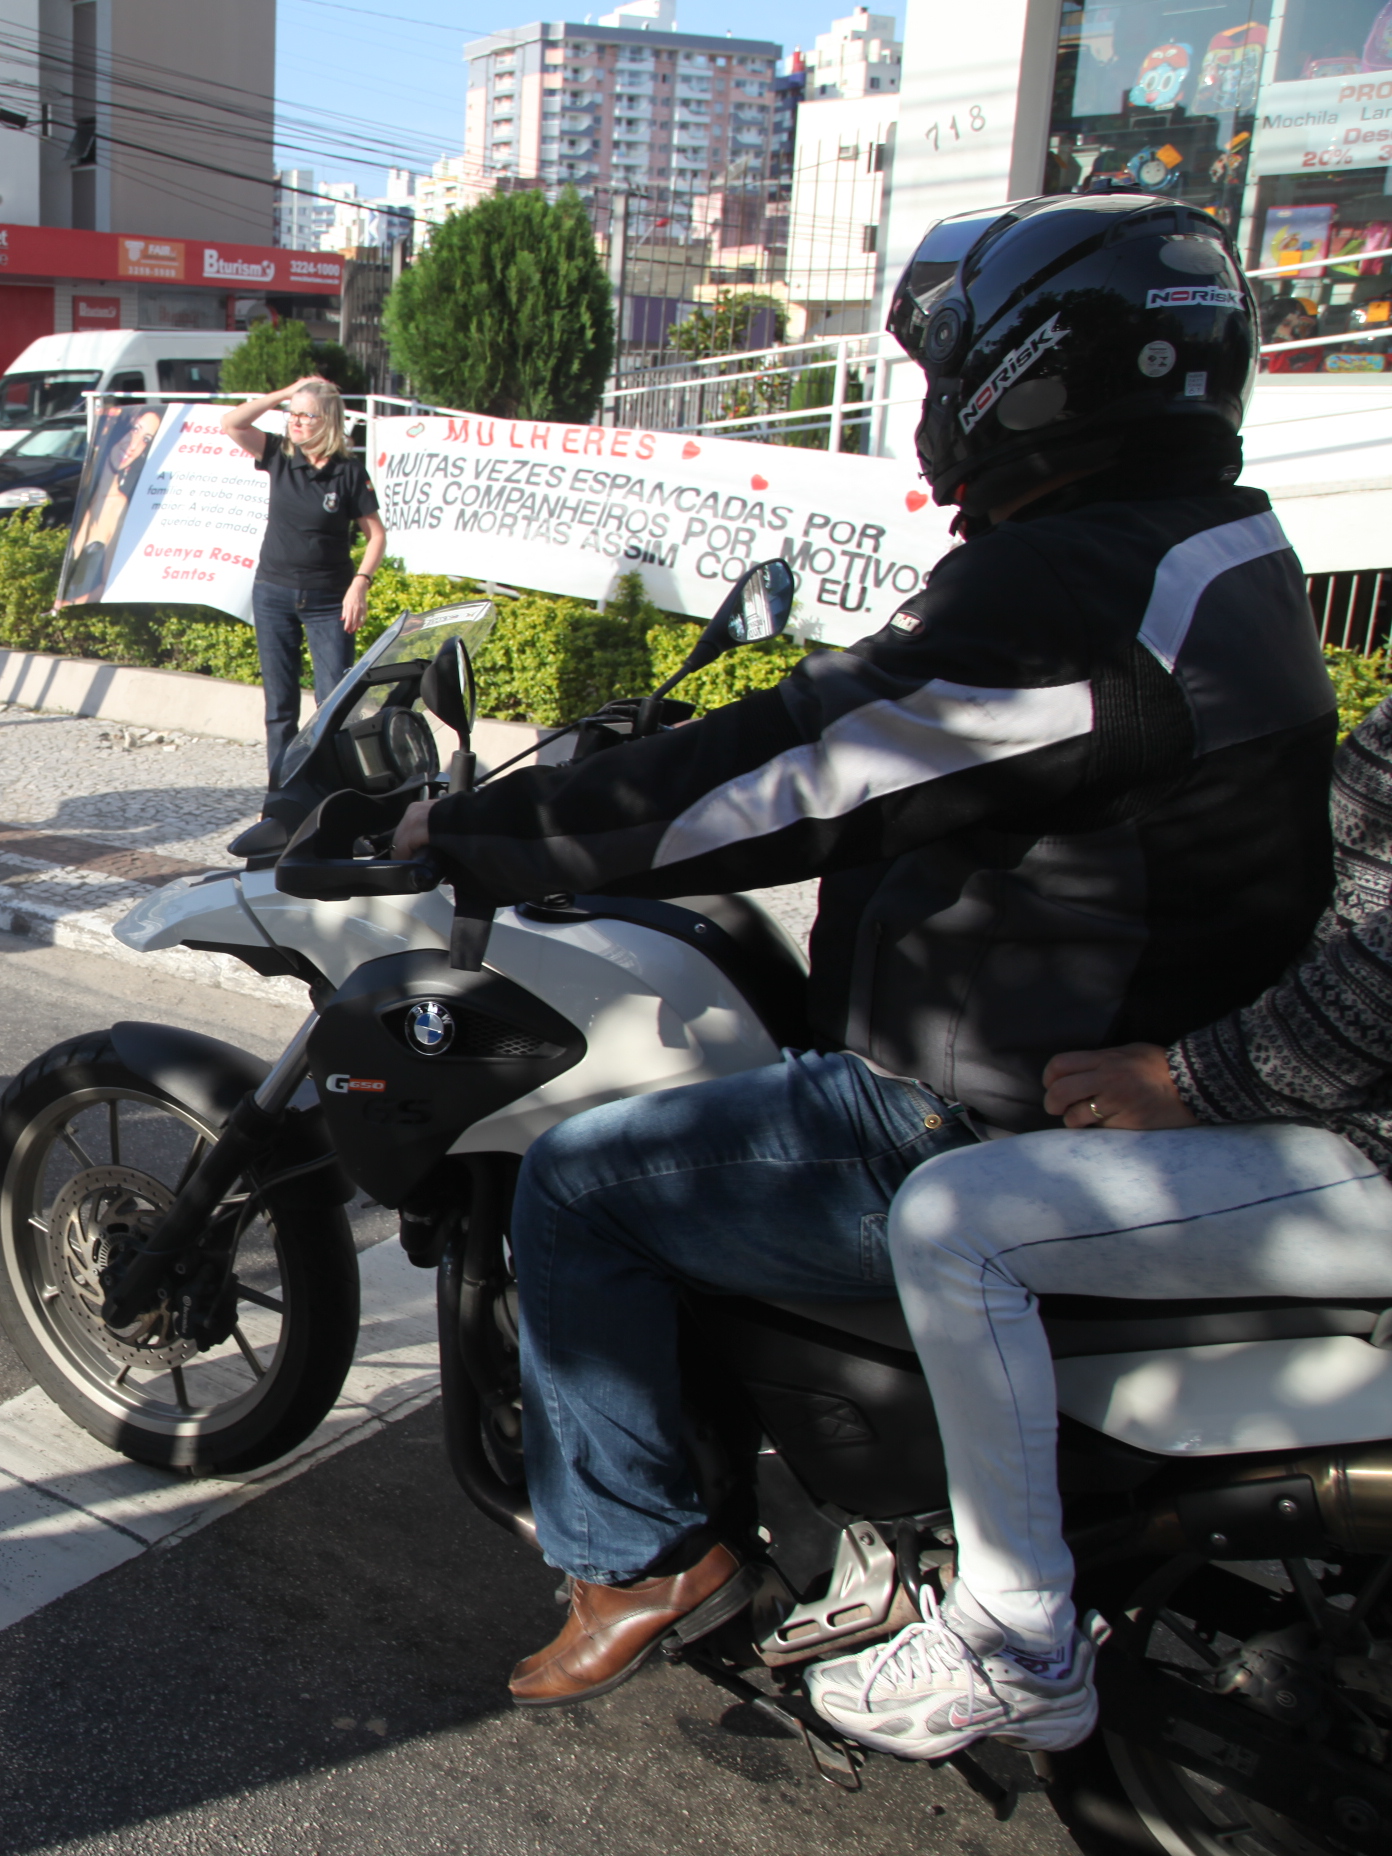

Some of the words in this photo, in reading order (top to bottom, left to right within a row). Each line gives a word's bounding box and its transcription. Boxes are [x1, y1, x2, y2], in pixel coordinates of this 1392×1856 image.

[925, 105, 986, 151] 718
[1263, 111, 1339, 129] Mochila
[1302, 149, 1353, 167] 20%
[178, 442, 223, 455] estão
[443, 419, 657, 460] MULHERES
[221, 475, 268, 489] adentra
[199, 488, 233, 500] rouba
[201, 503, 225, 514] vida
[228, 504, 243, 516] da
[247, 508, 270, 521] nos
[474, 458, 567, 489] VEZES
[569, 468, 794, 531] ESPANCADAS
[802, 512, 886, 553] POR
[215, 521, 258, 535] amada
[384, 480, 432, 507] SEUS
[442, 480, 671, 539] COMPANHEIROS
[682, 516, 756, 559] POR
[143, 543, 204, 561] Quenya
[209, 547, 255, 569] Rosa
[454, 509, 571, 546] MORTAS
[580, 527, 679, 569] ASSIM
[816, 577, 871, 613] EU.
[162, 566, 216, 582] Santos
